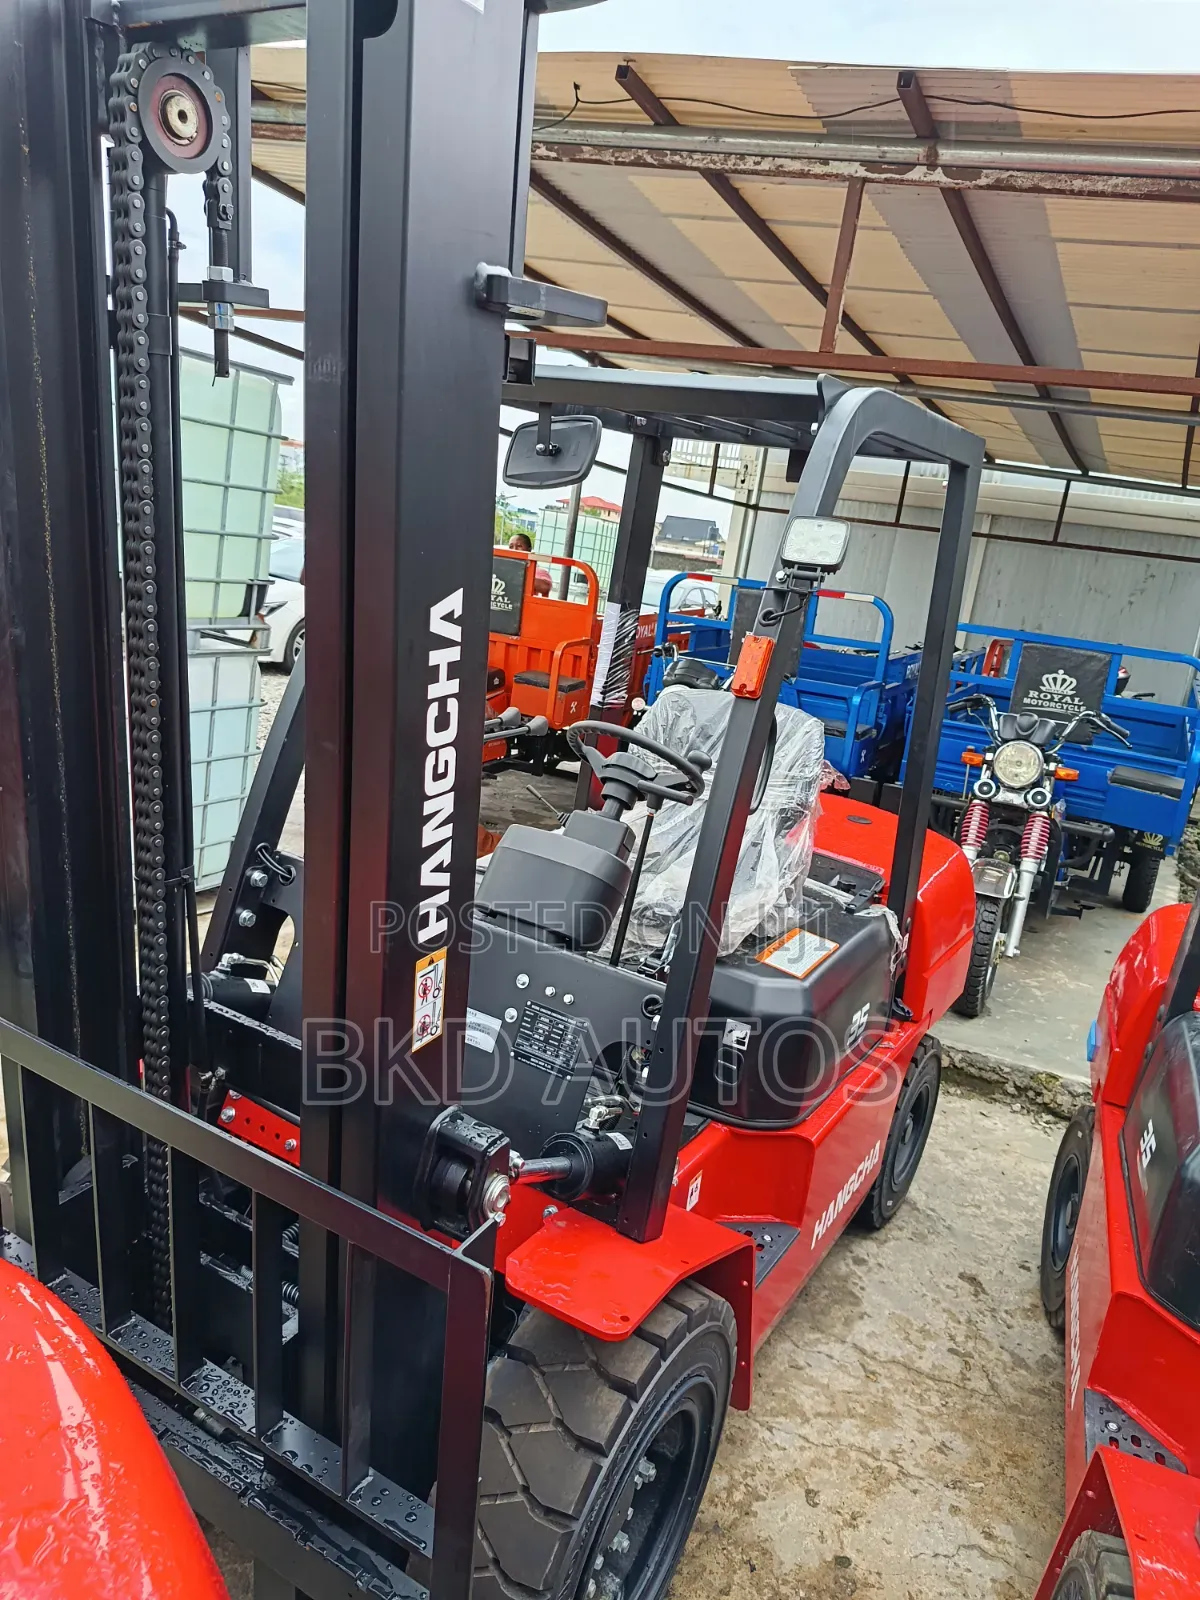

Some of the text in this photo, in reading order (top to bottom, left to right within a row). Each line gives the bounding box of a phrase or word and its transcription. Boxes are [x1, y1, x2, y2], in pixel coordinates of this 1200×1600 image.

[1022, 697, 1087, 712] MOTORCYCLE
[1028, 690, 1084, 706] ROYAL
[417, 586, 464, 945] HANGCHA
[846, 1002, 870, 1046] 35
[1139, 1118, 1157, 1169] 35
[810, 1139, 881, 1251] HANGCHA
